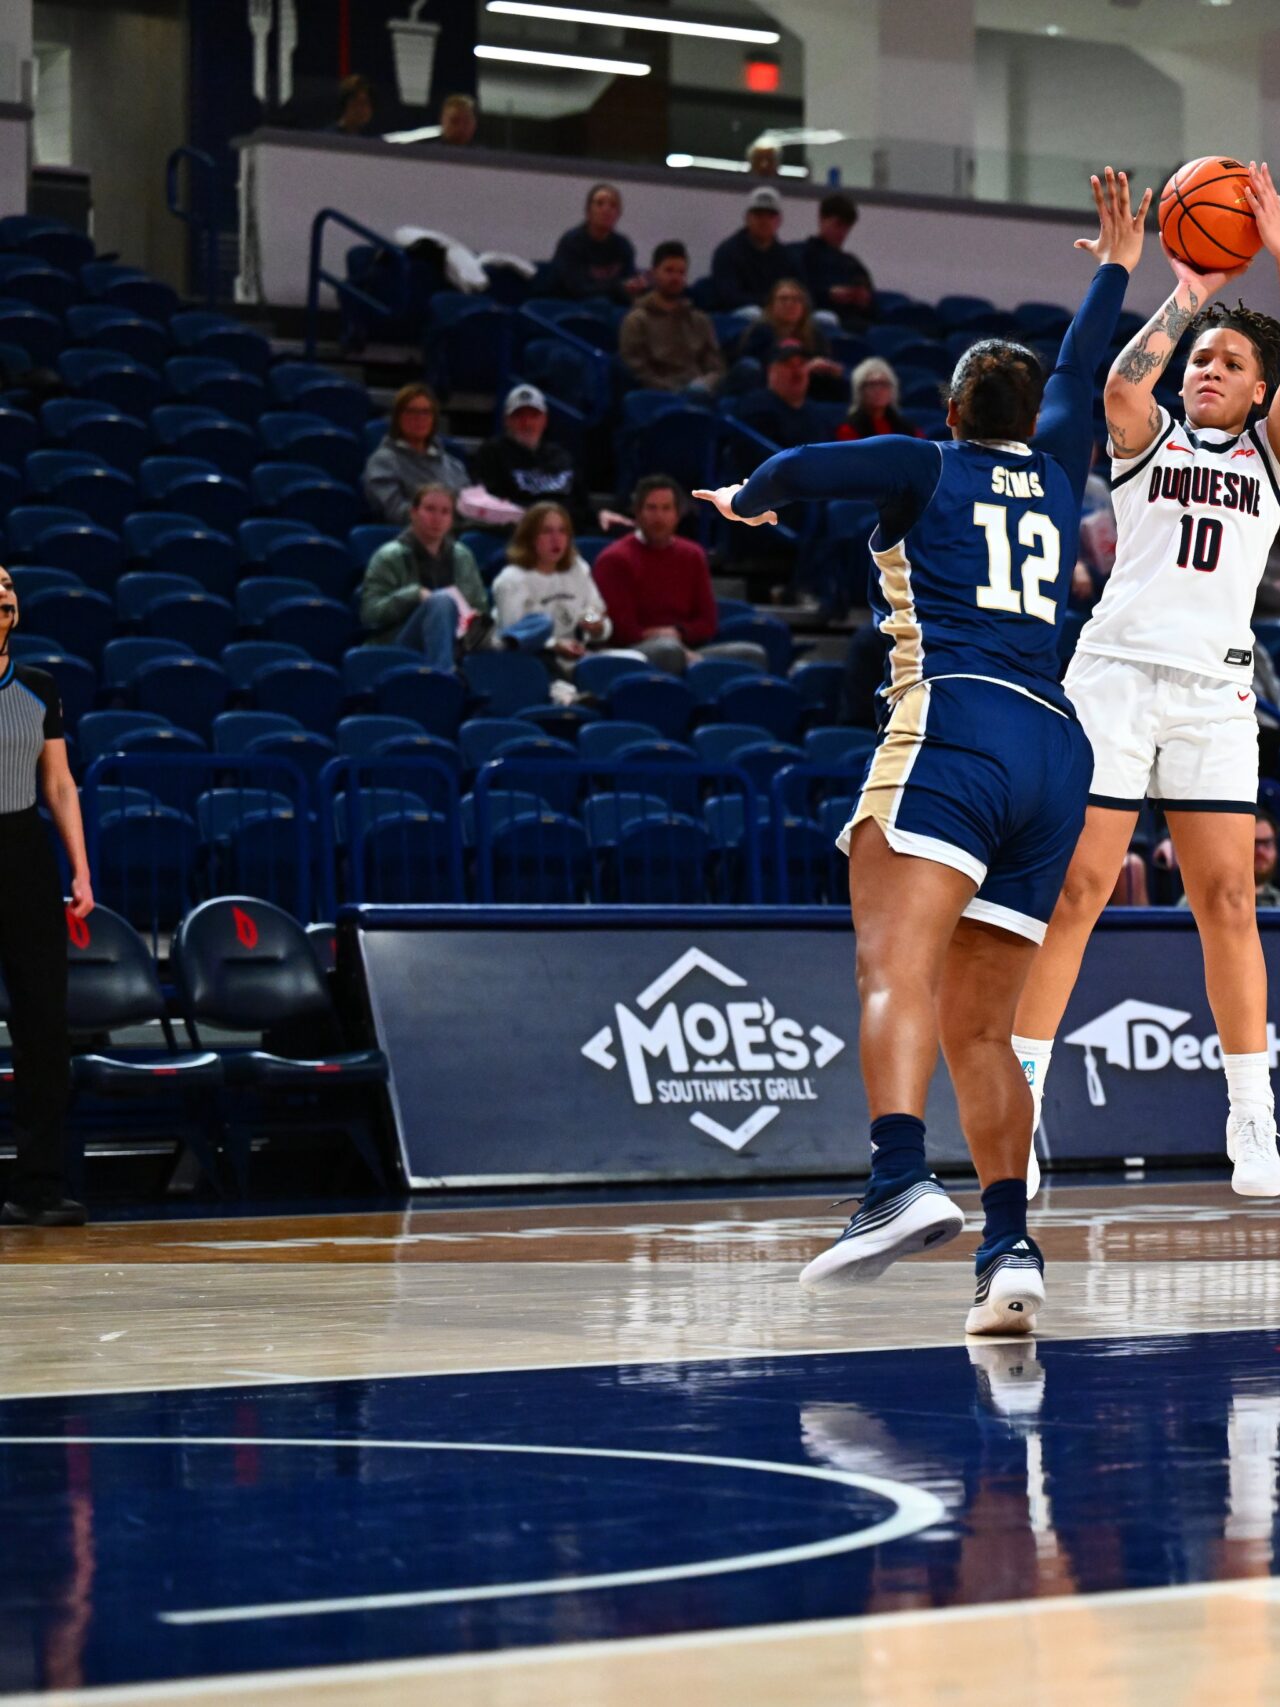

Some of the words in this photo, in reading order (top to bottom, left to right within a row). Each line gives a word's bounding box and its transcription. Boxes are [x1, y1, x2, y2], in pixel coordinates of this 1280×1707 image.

[991, 465, 1045, 498] SIMS
[1148, 465, 1261, 518] DUQUESNE
[973, 501, 1061, 626] 12
[1176, 513, 1224, 573] 10
[656, 1078, 762, 1103] SOUTHWEST
[764, 1077, 819, 1101] GRILL
